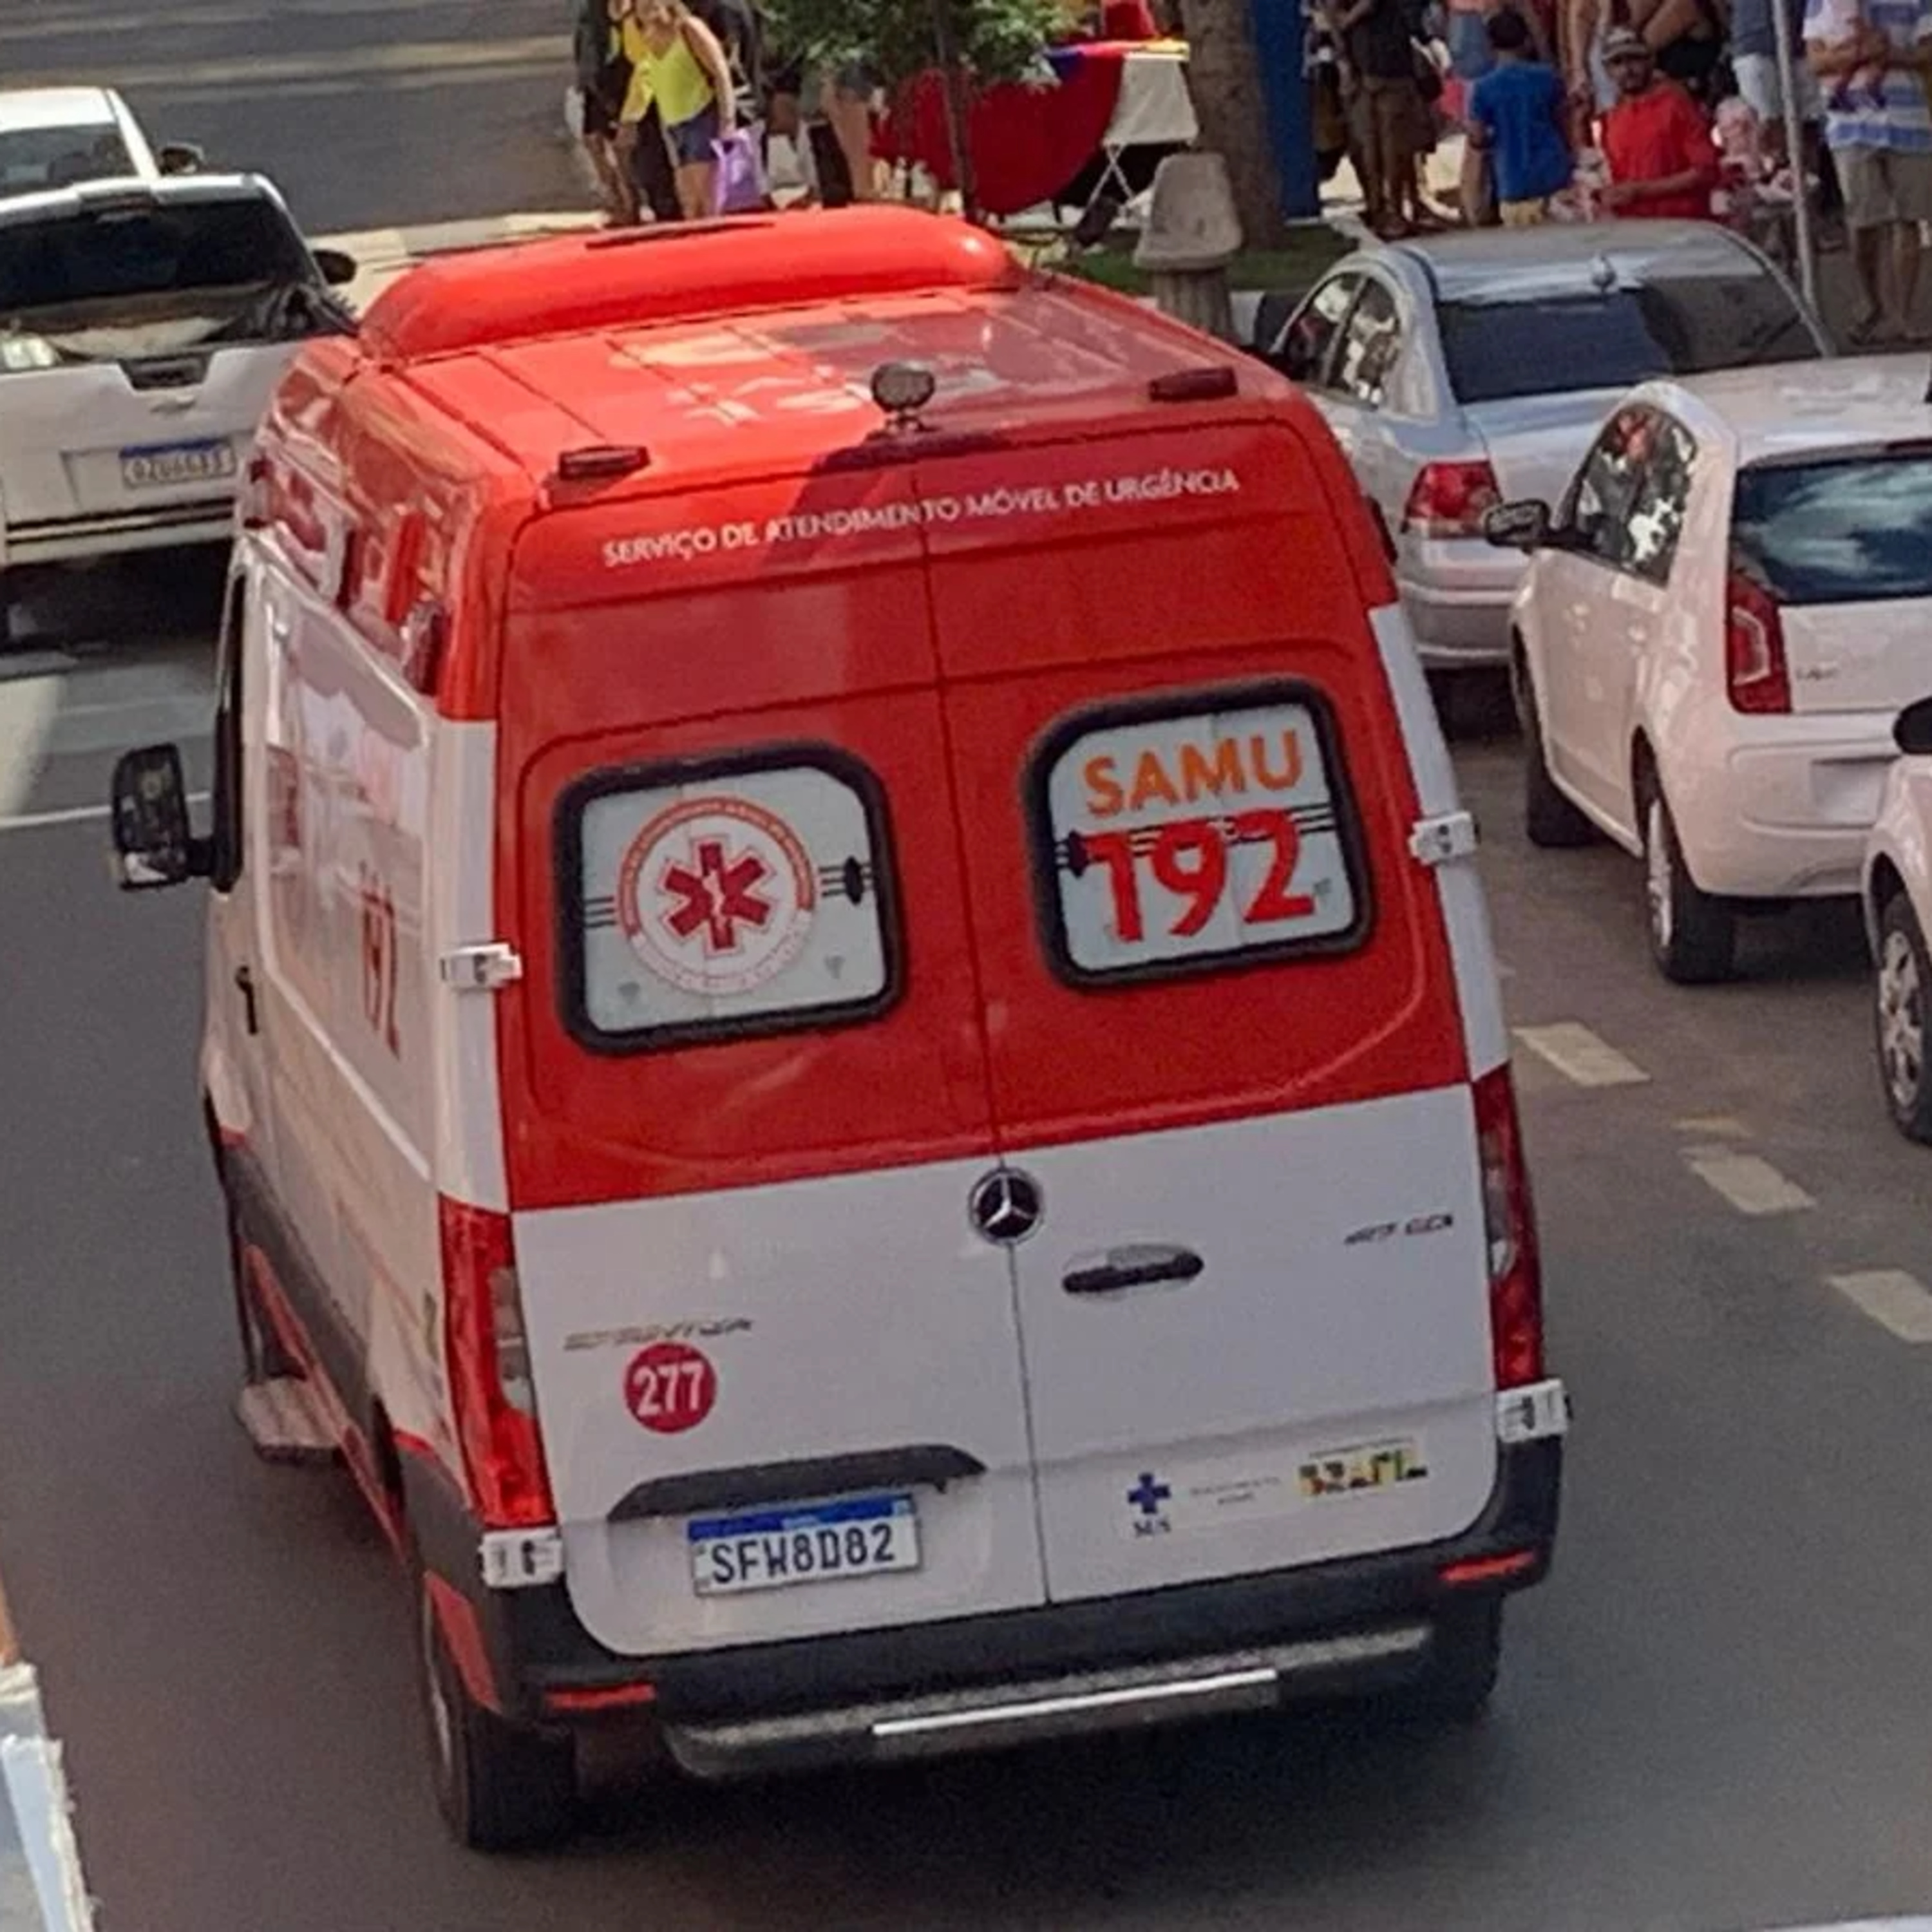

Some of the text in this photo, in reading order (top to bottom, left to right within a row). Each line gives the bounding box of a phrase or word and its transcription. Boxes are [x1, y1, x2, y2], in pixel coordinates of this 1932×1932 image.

[602, 468, 1240, 567] SERVIÇO DE ATENDIMENTO MÓVEL DE URGÊNCIA
[1083, 729, 1303, 818] SAMU
[1084, 808, 1315, 942] 192
[632, 1360, 705, 1417] 277
[712, 1522, 895, 1584] SFW8D82
